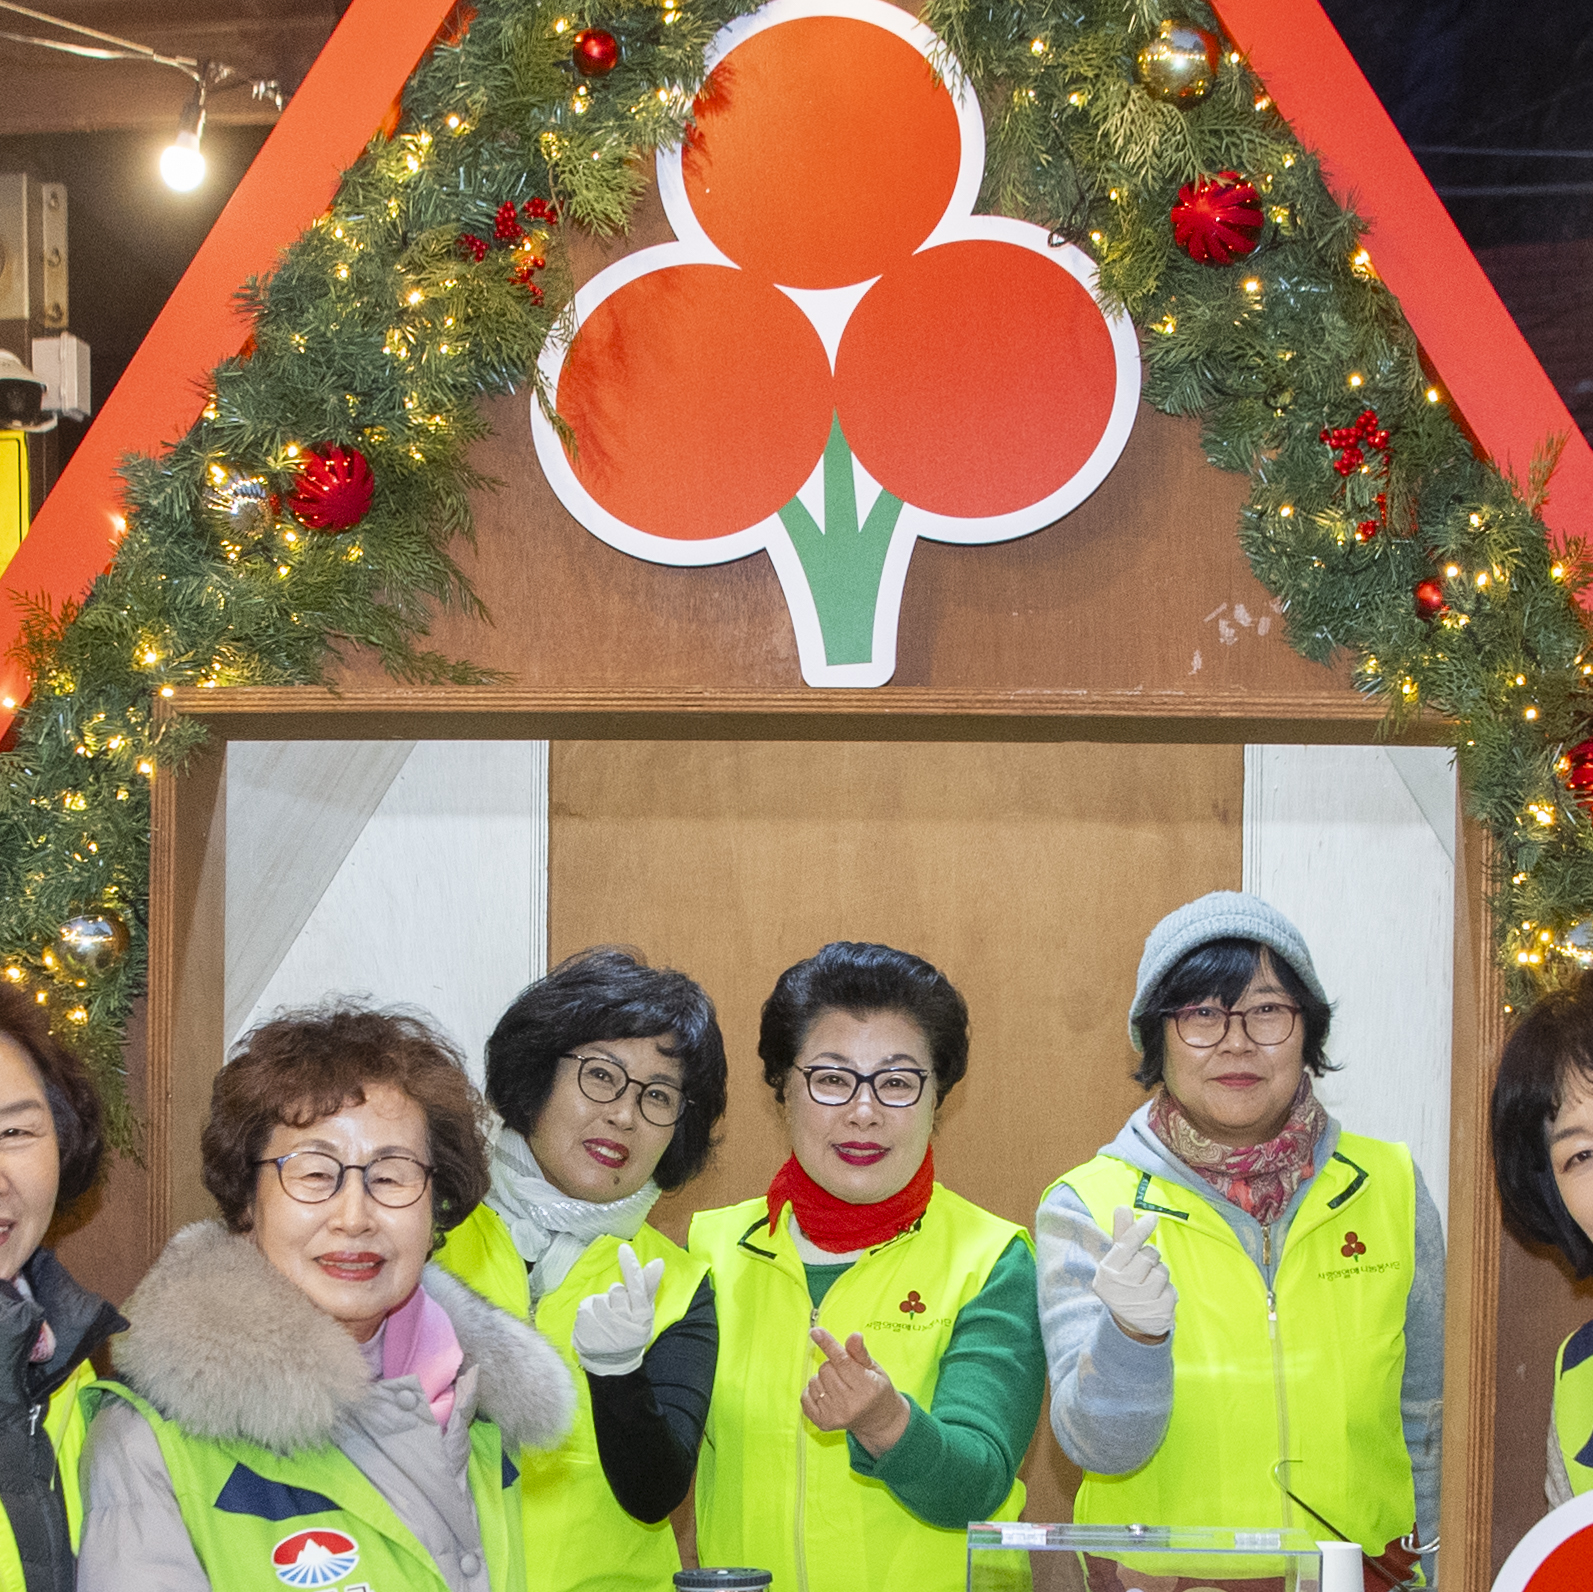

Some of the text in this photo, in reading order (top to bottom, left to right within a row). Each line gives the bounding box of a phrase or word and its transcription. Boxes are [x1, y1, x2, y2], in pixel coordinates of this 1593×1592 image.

[1318, 1261, 1401, 1282] 사랑의열매 나눔봉사단
[865, 1320, 911, 1333] 사랑의열매
